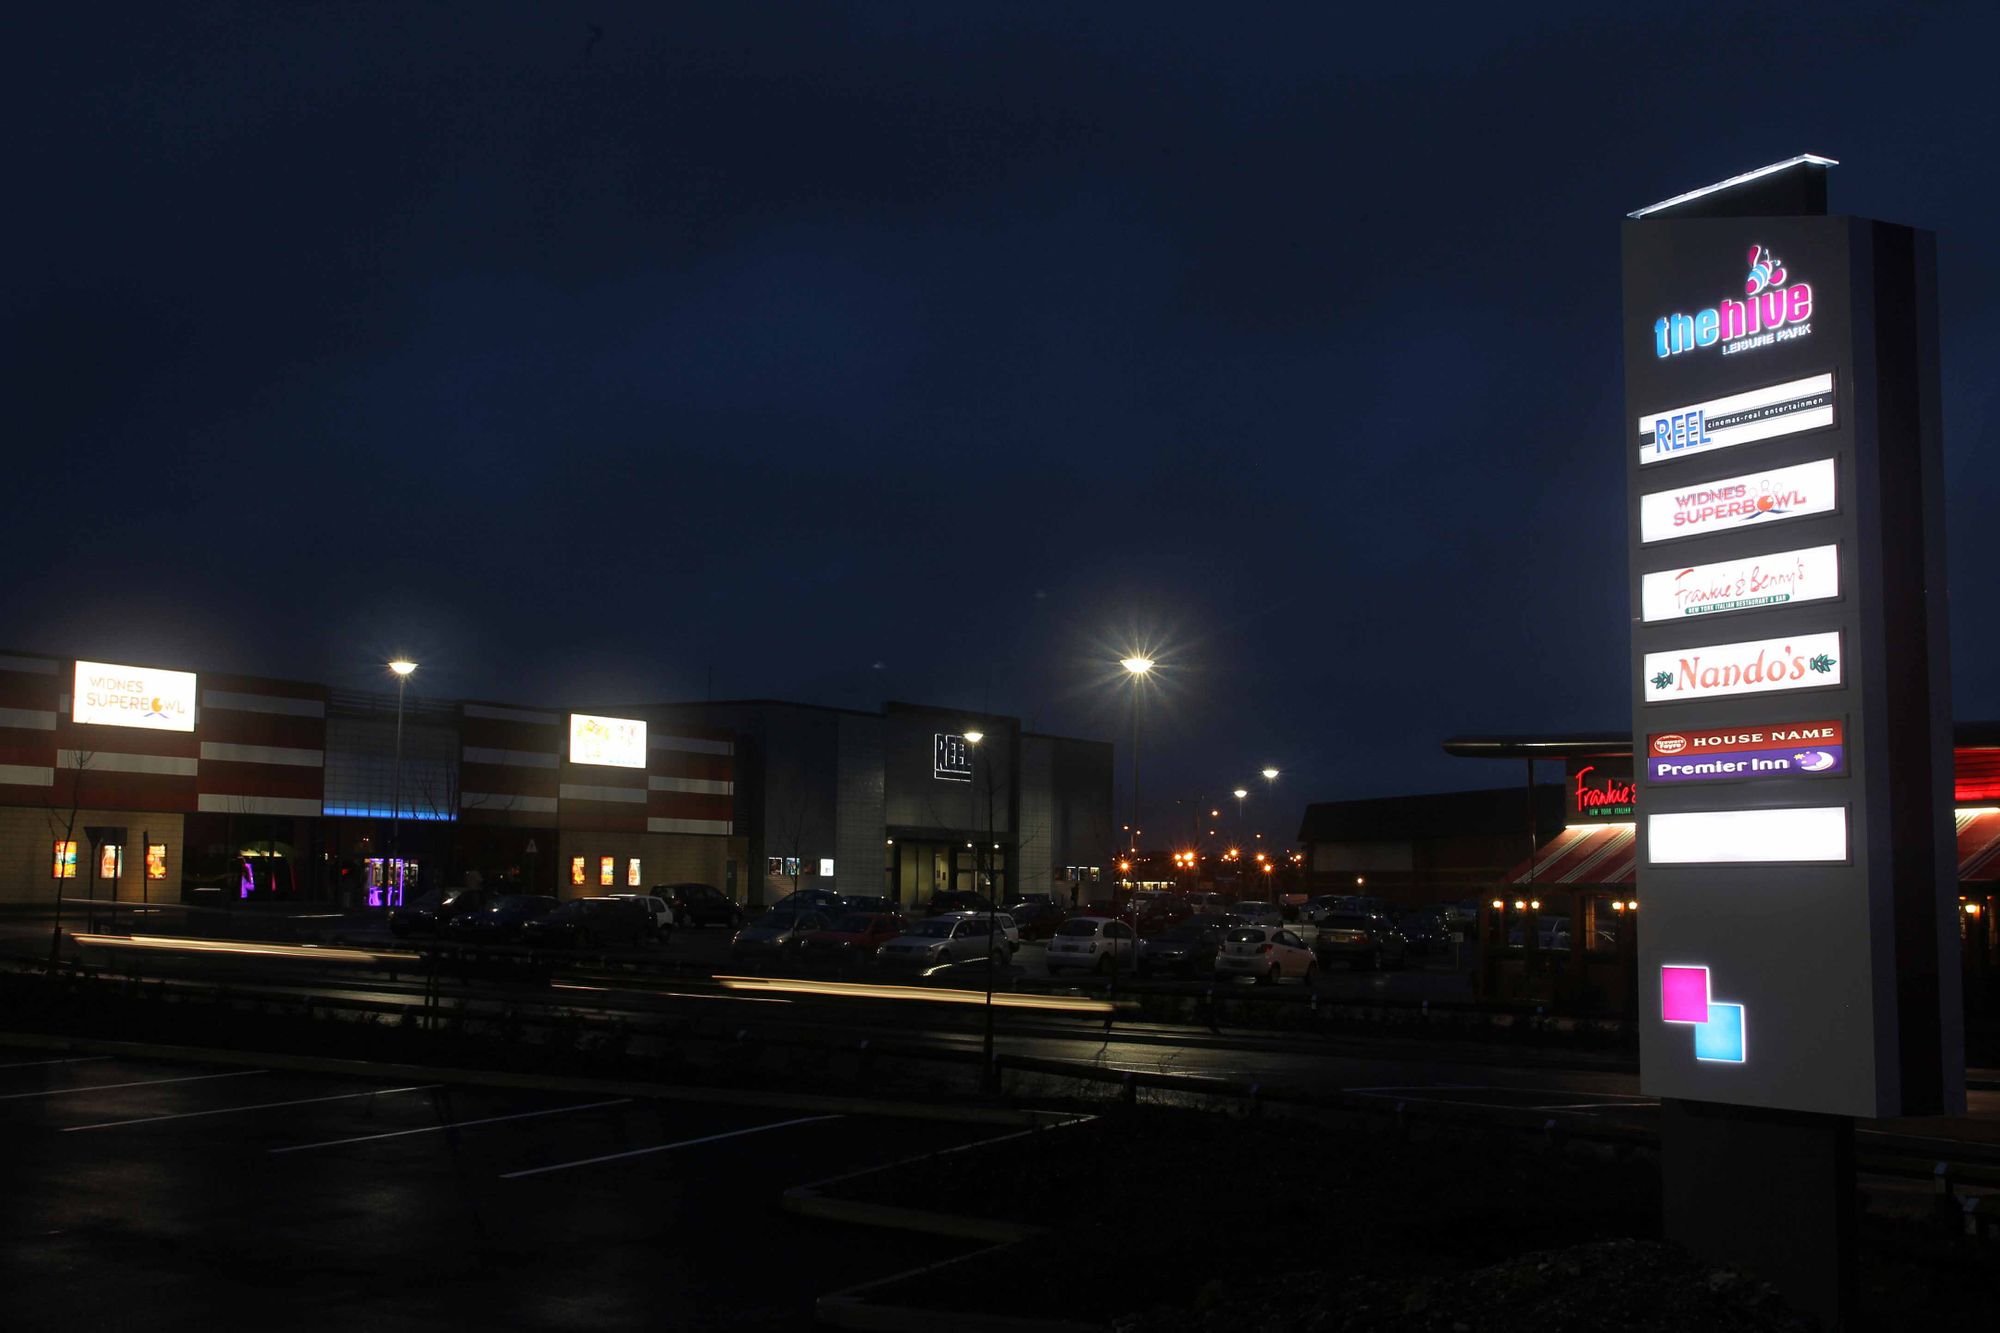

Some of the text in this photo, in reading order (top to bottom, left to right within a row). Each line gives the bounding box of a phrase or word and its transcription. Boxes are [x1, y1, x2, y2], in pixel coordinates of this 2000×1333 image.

[1722, 324, 1812, 356] LEISURE PARK
[1655, 409, 1711, 454] REEL
[1675, 484, 1747, 508] WIDNES
[1674, 568, 1731, 608] Frankie
[1750, 556, 1805, 595] Benny's
[1675, 645, 1805, 691] Nando's
[89, 677, 144, 693] WIDNES
[1693, 727, 1834, 747] HOUSE NAME
[1657, 757, 1790, 776] Premier Inn
[1575, 766, 1630, 812] Frankie
